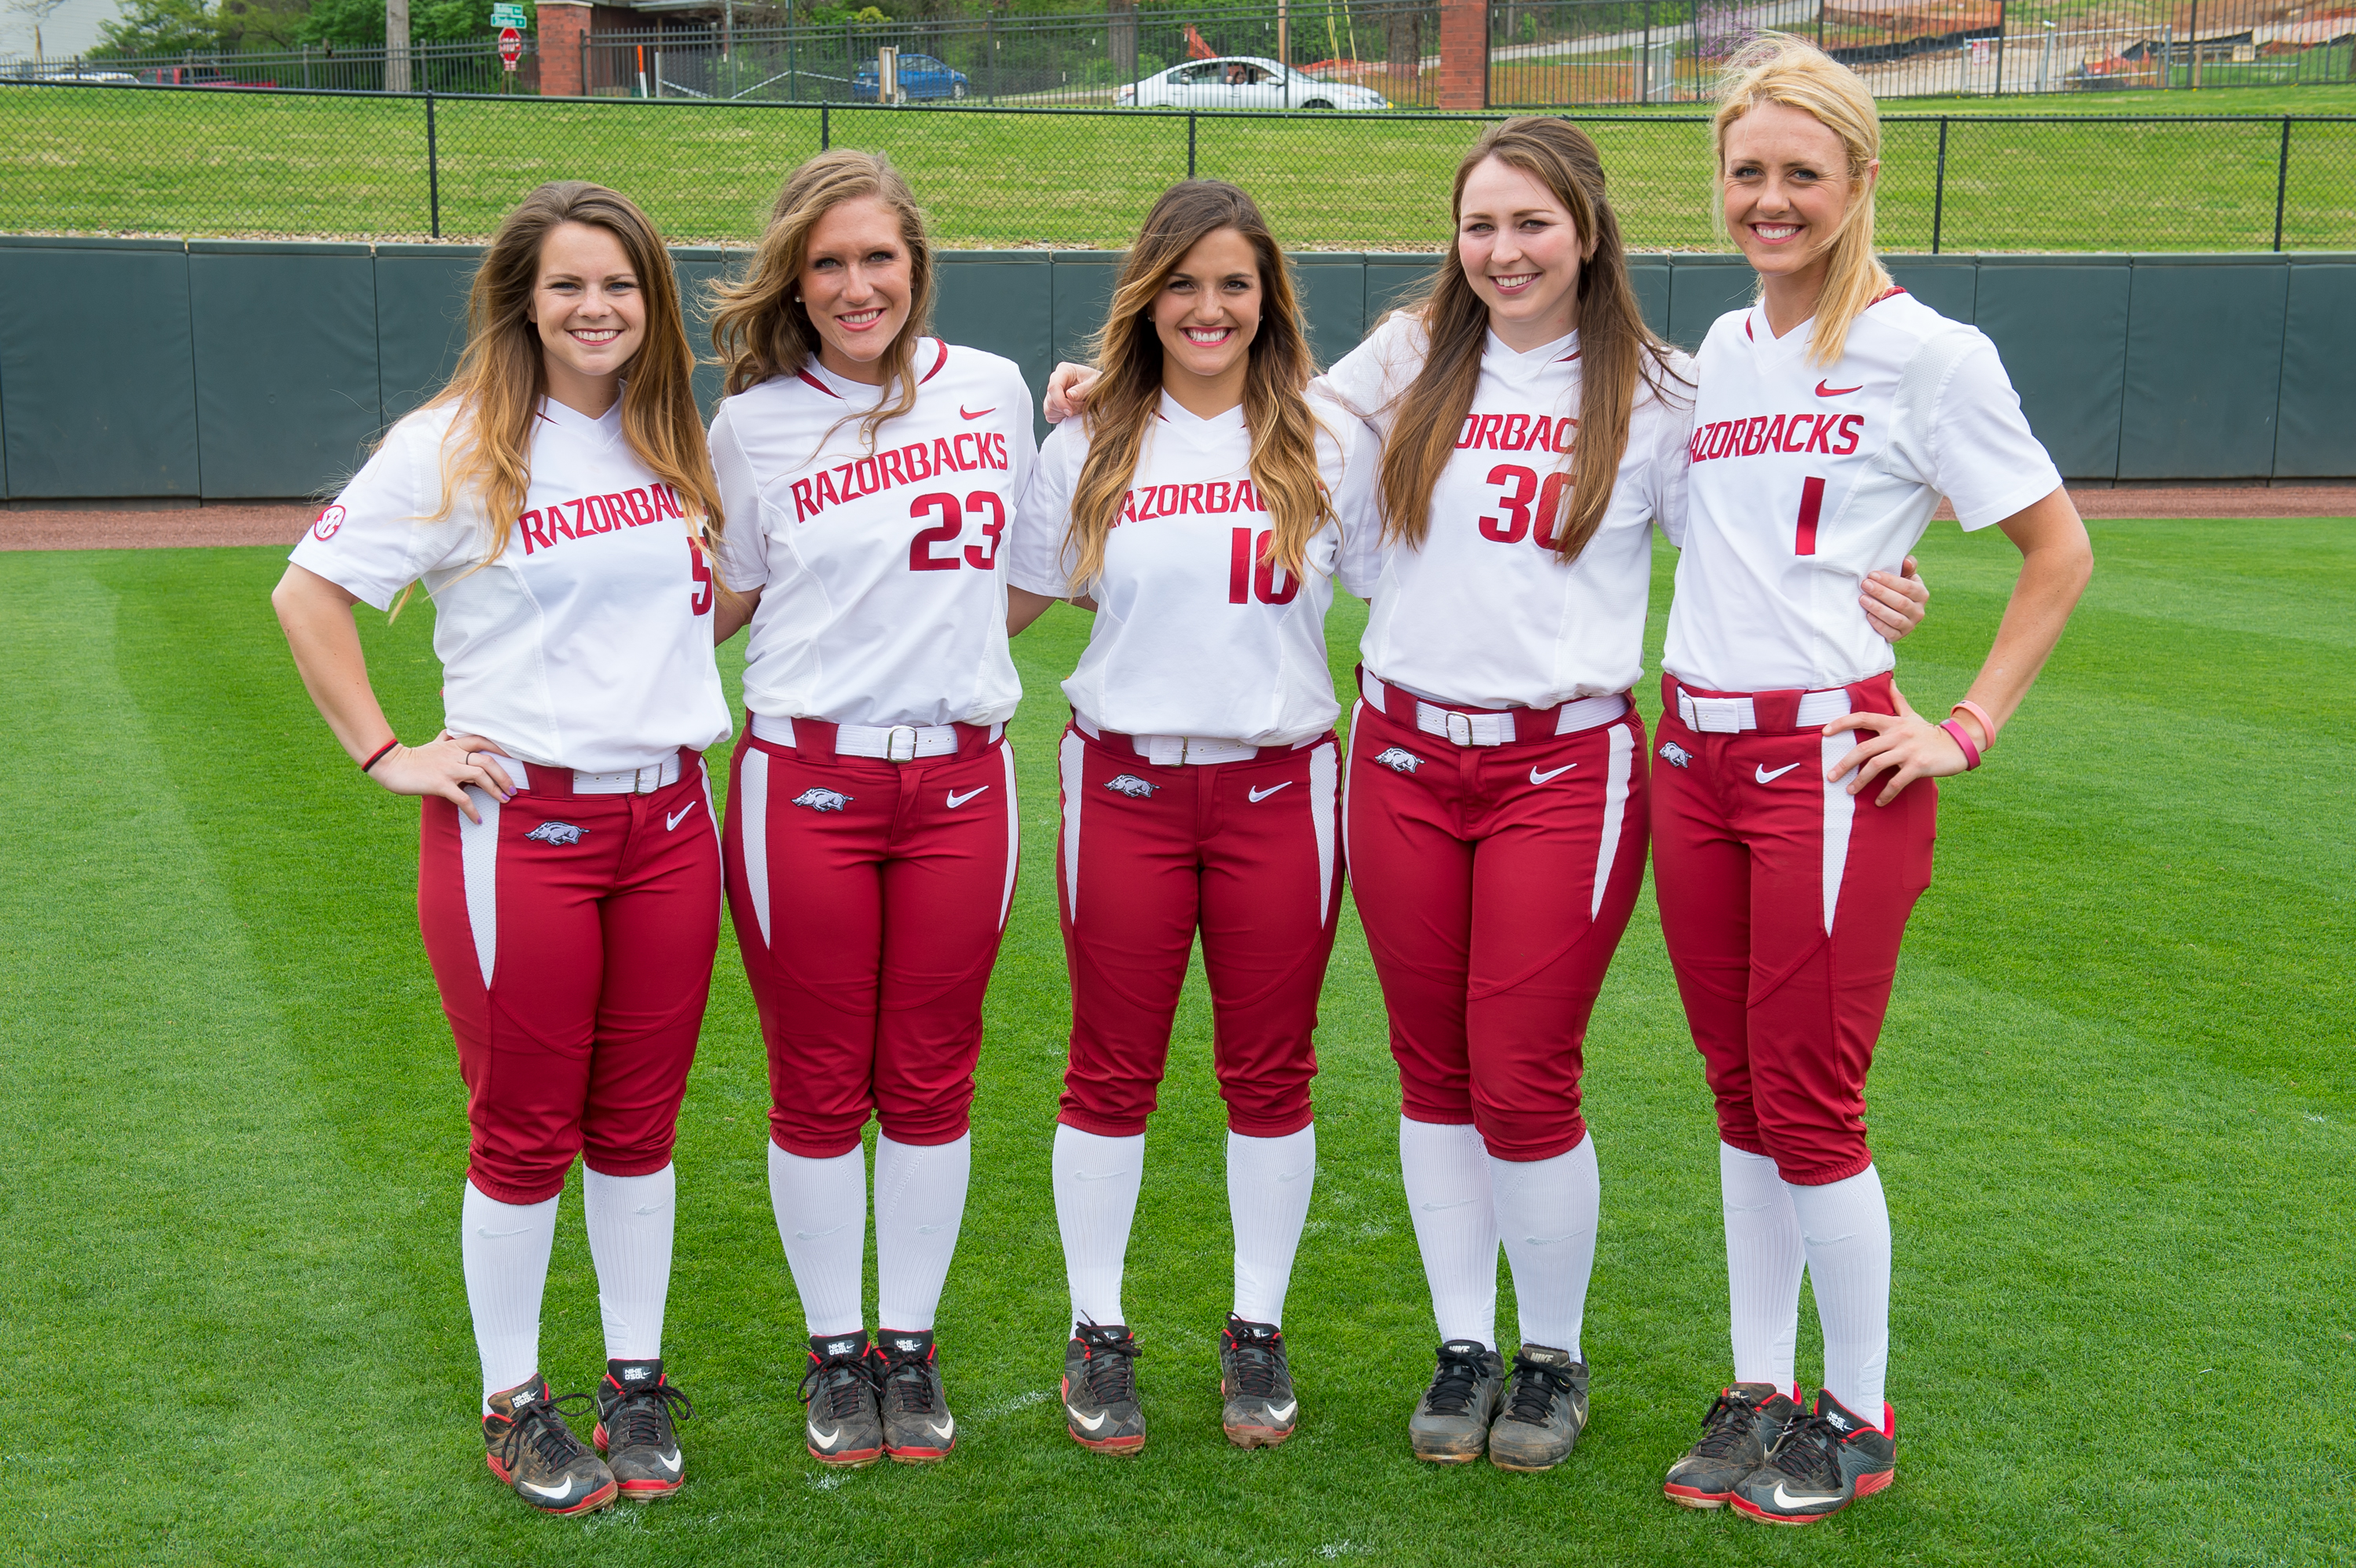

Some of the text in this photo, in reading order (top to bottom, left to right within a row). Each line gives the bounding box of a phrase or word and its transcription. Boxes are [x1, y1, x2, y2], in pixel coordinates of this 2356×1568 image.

[1454, 413, 1580, 455] ORBAC
[1688, 414, 1864, 467] AZORBACKS
[789, 432, 1008, 524] RAZORBACKS
[1107, 479, 1323, 529] AZORBA
[1478, 463, 1579, 553] 30
[1795, 476, 1826, 556] 1
[909, 490, 1006, 572] 23
[686, 536, 713, 616] 5
[1228, 527, 1304, 605] 10
[829, 1342, 845, 1351] NIKE
[1448, 1345, 1470, 1354] NIKE
[1531, 1352, 1554, 1363] NIKE
[511, 1391, 529, 1403] NIKE
[1828, 1411, 1846, 1424] NIKE
